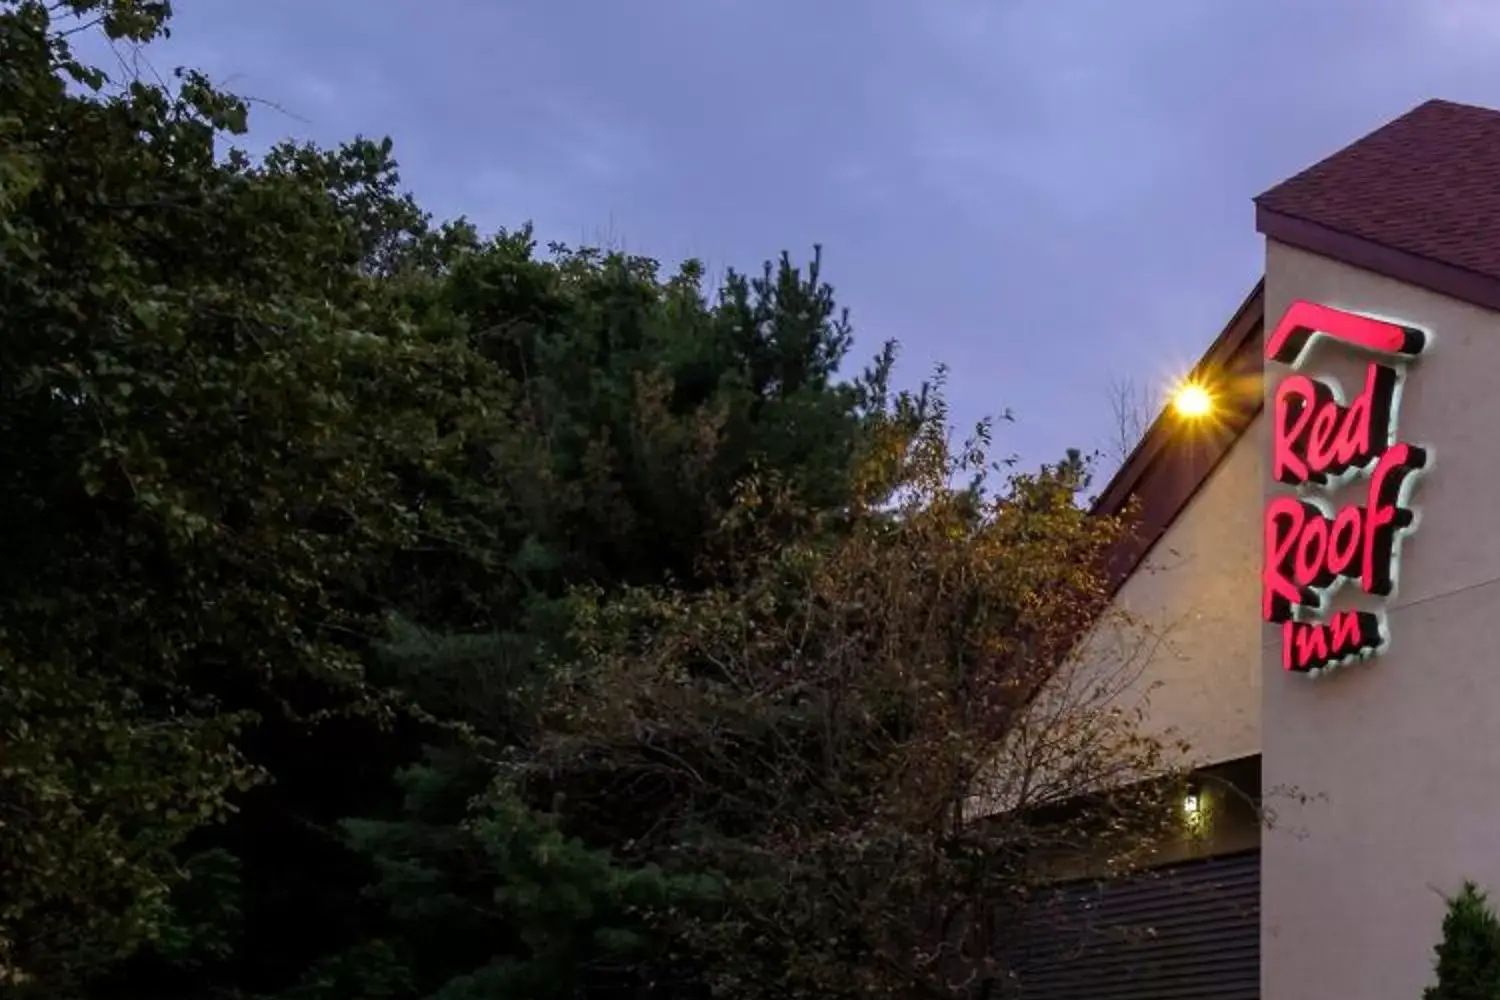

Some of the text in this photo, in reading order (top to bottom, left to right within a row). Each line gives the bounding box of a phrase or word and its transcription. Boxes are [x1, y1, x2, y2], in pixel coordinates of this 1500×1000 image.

[1272, 362, 1379, 483] Red
[1262, 443, 1410, 622] Roof
[1282, 608, 1362, 671] Inn
